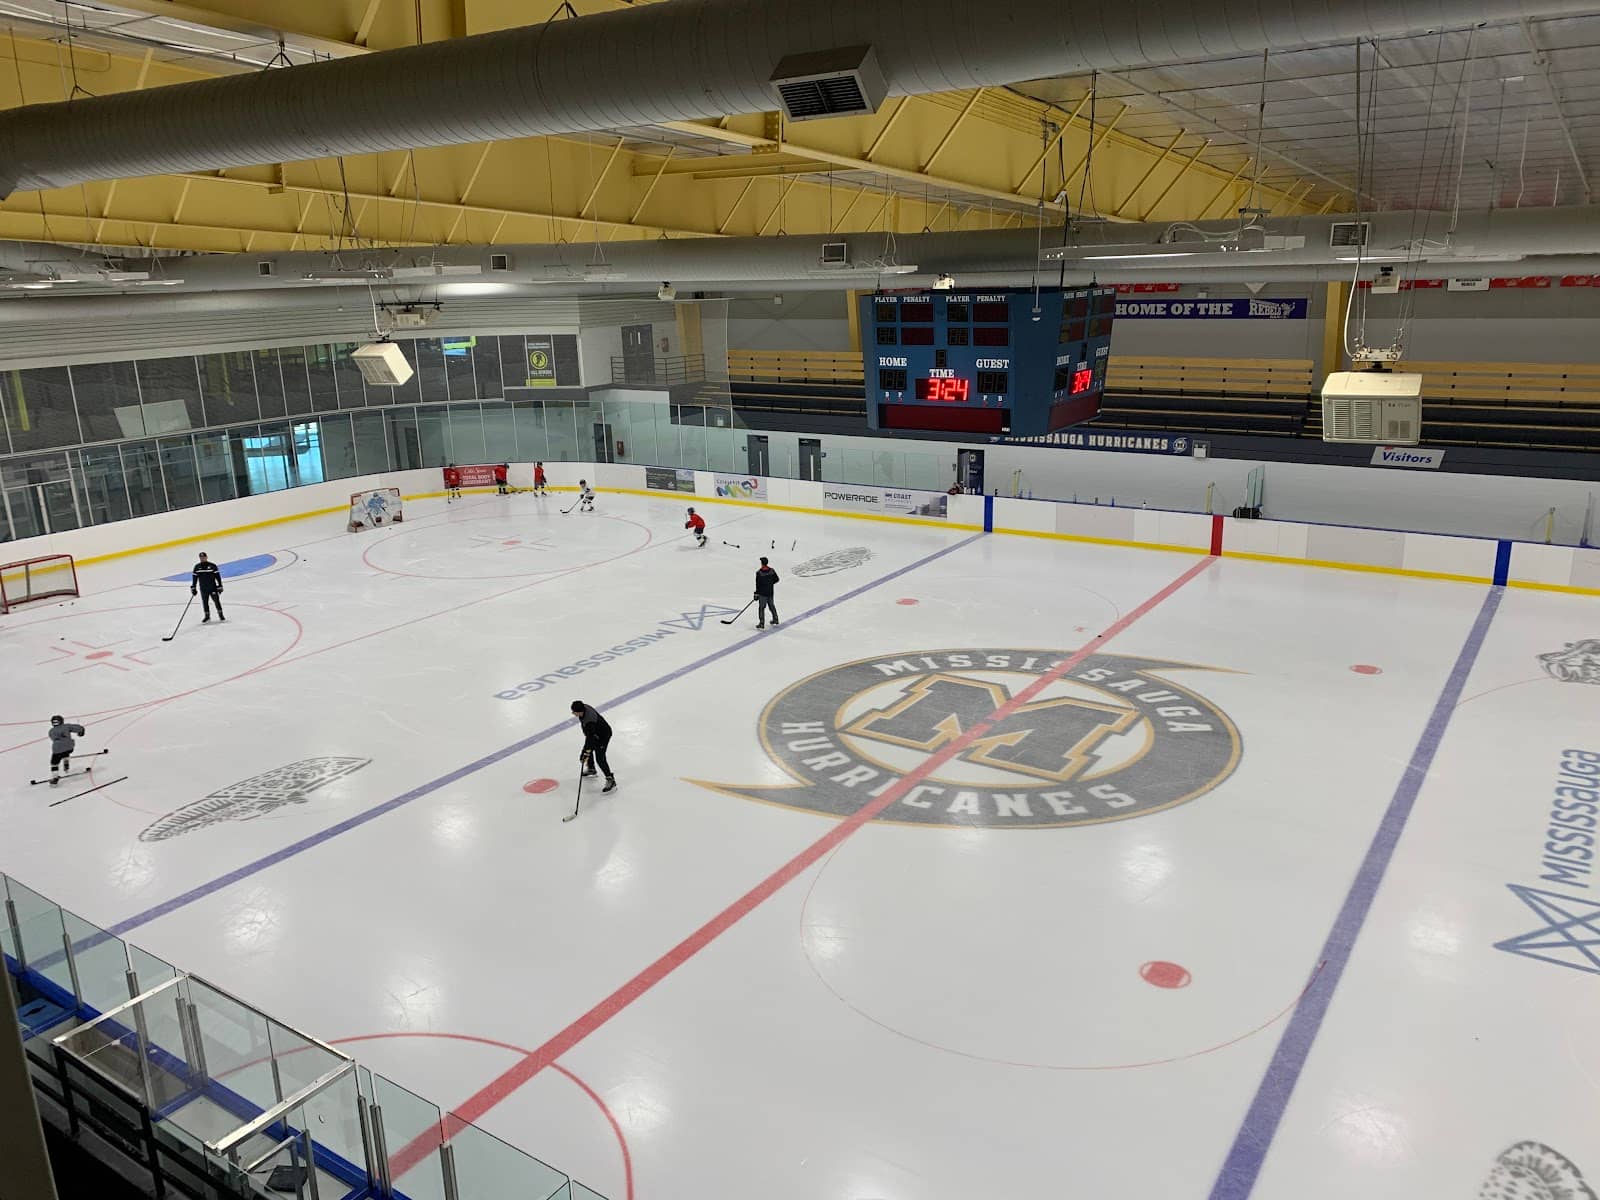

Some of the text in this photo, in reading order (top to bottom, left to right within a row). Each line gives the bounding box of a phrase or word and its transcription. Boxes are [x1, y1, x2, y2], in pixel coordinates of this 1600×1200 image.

[1115, 303, 1167, 315] HOME
[1170, 303, 1196, 315] OF
[1197, 302, 1233, 315] THE
[879, 357, 908, 367] HOME
[975, 359, 1010, 369] GUEST
[928, 368, 955, 378] TIME
[927, 378, 969, 401] 3:24
[1088, 434, 1169, 450] HURRICANES
[1383, 451, 1433, 464] Visitors
[824, 491, 880, 503] POWERADE
[781, 720, 1137, 817] HURRICANES
